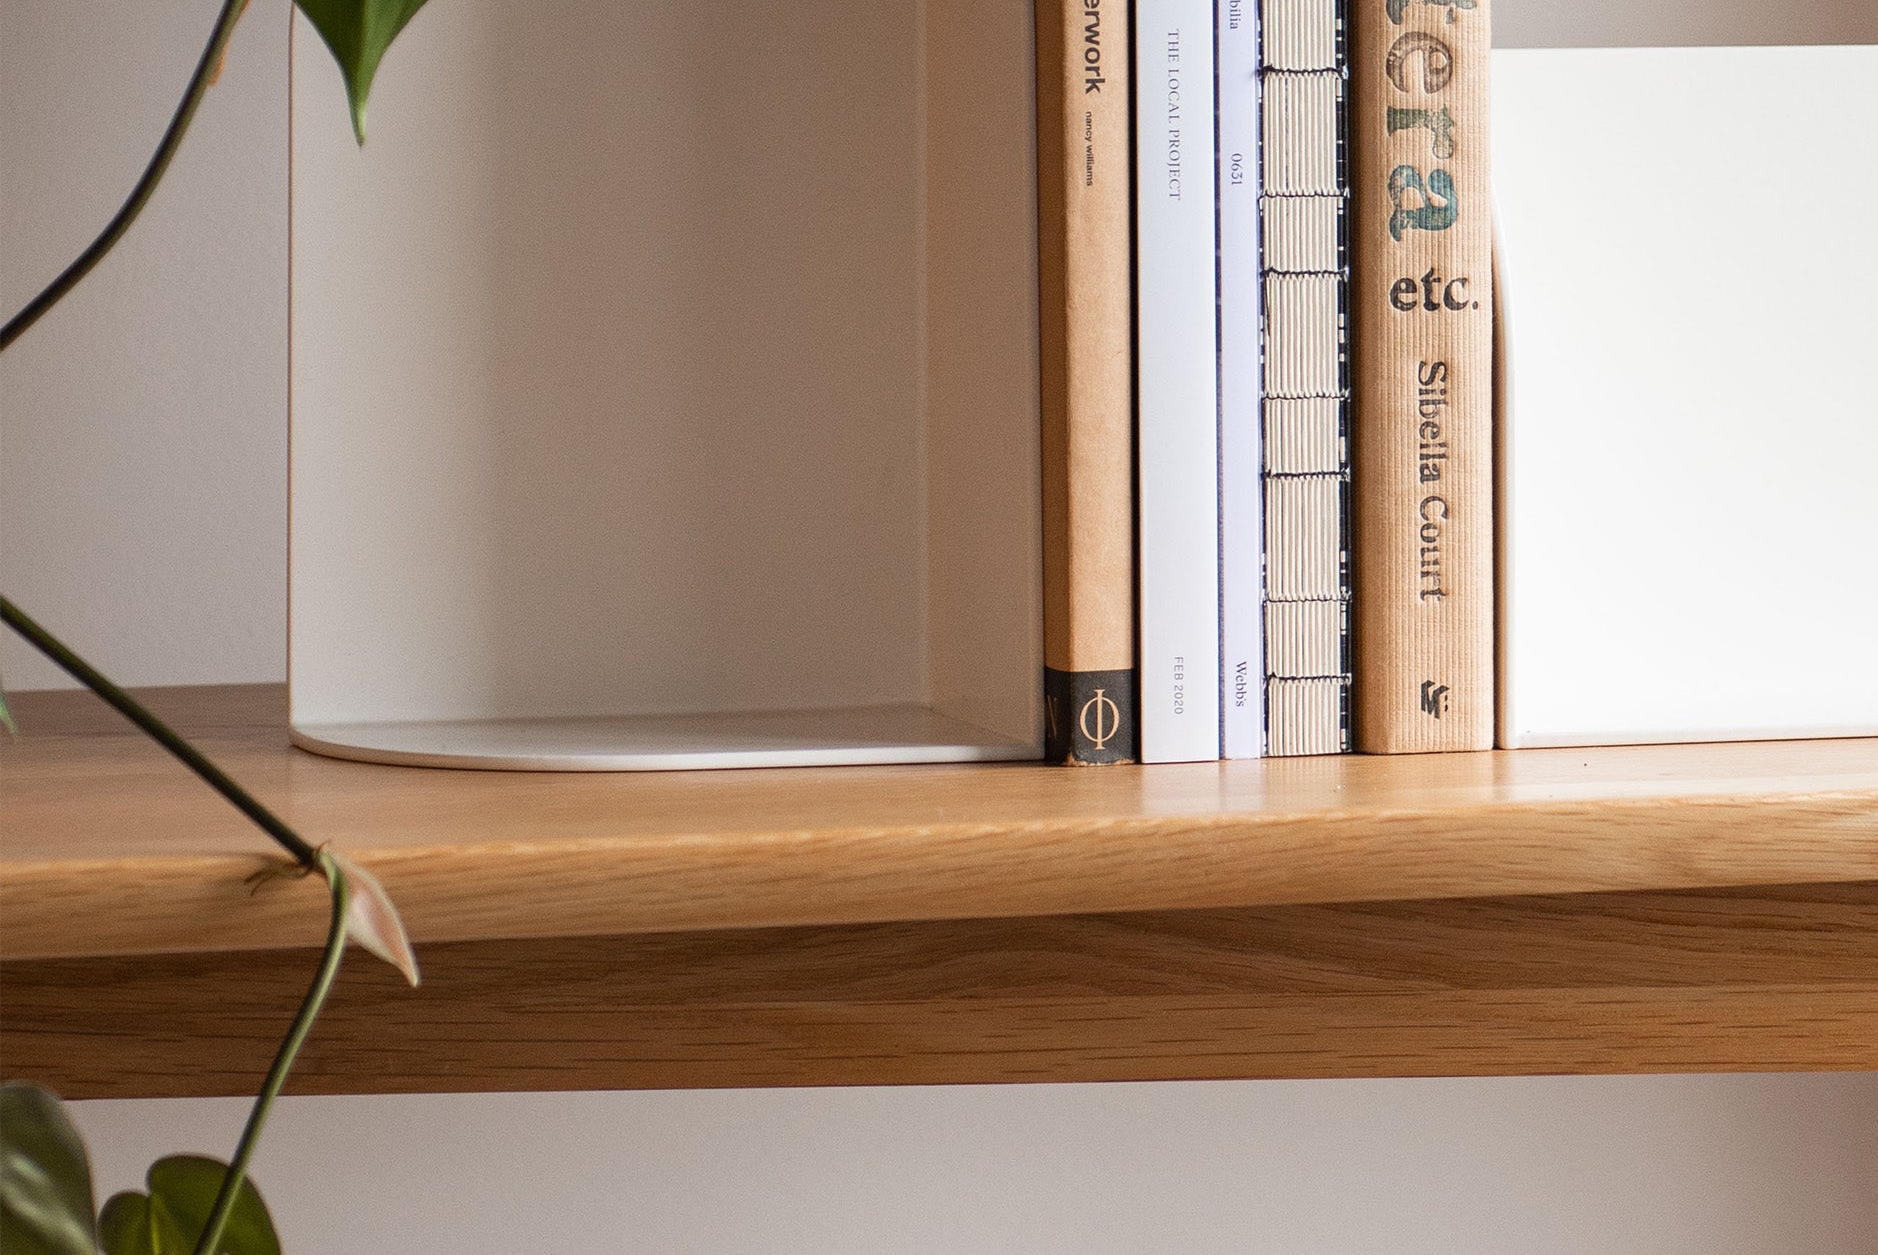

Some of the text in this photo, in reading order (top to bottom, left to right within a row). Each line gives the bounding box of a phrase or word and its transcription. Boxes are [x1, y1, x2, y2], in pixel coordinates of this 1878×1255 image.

[1084, 110, 1095, 187] nancy williams
[1166, 27, 1182, 202] THE LOCAL PROJECT
[1230, 152, 1244, 186] 0631
[1389, 266, 1479, 312] etc.
[1416, 360, 1449, 602] Sibella Court
[1173, 656, 1185, 715] FEB 2020
